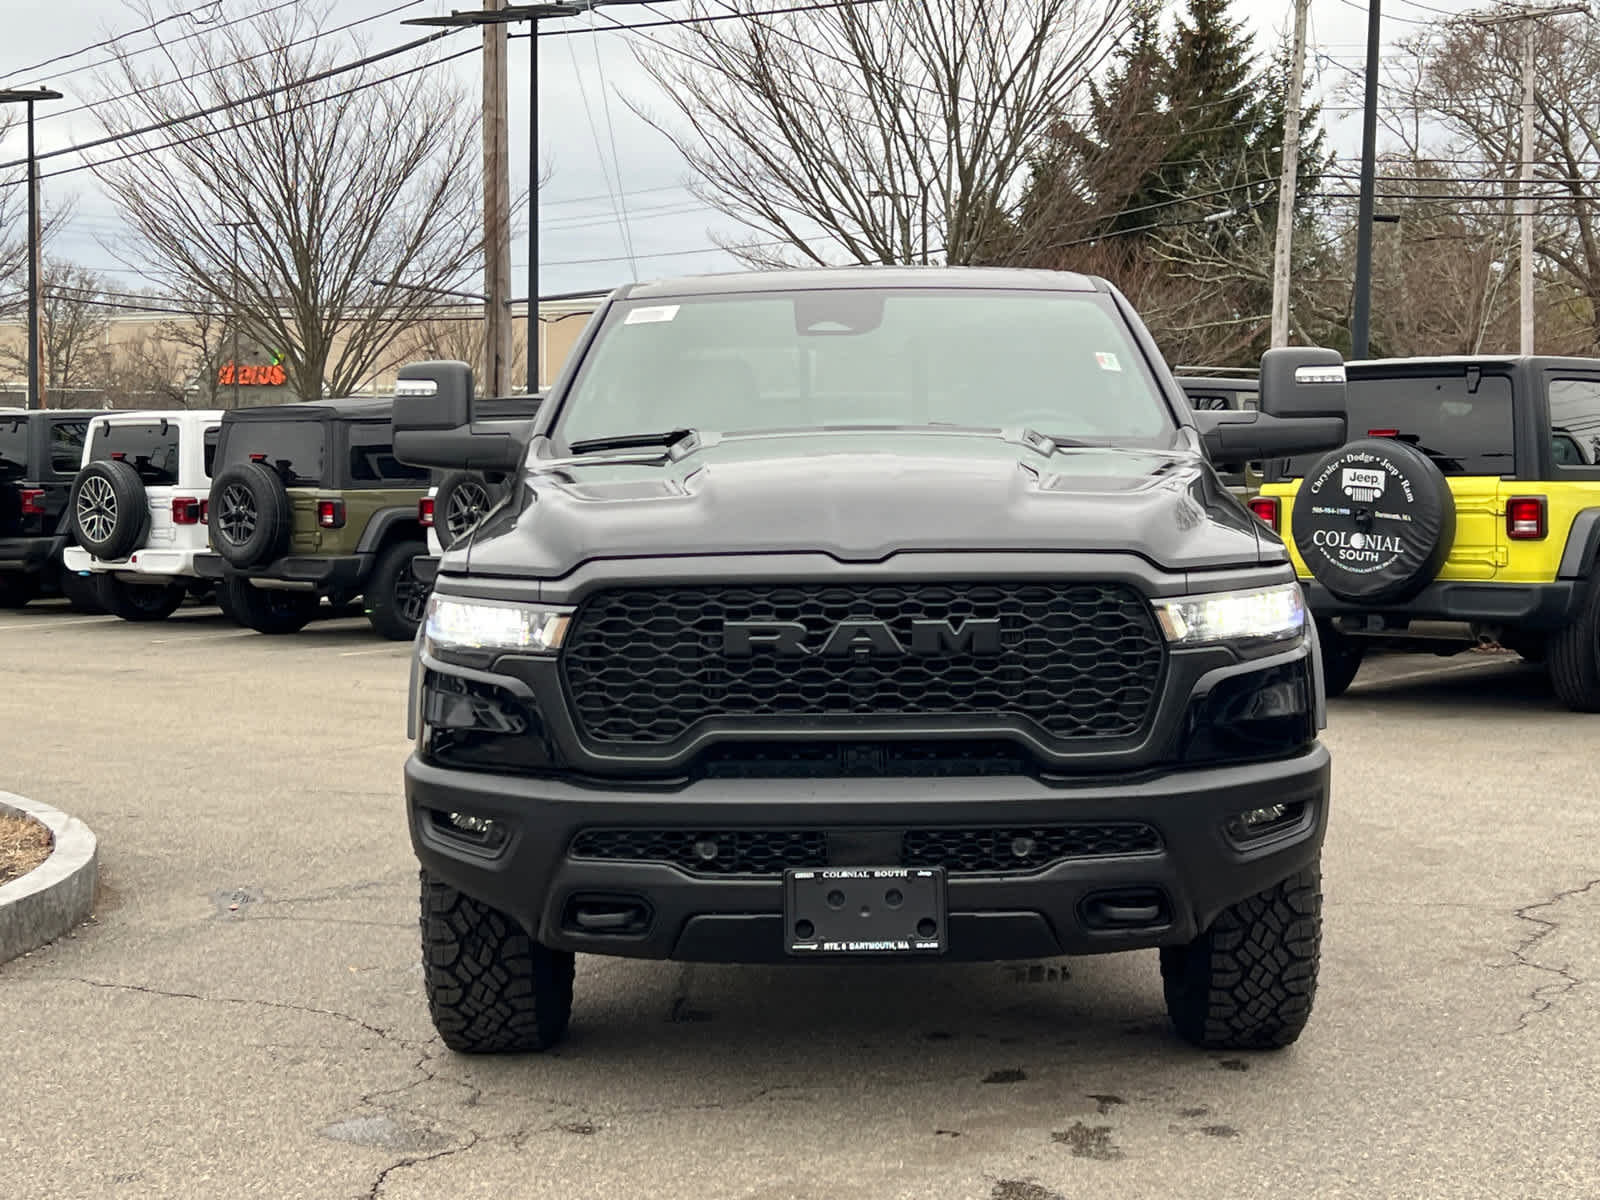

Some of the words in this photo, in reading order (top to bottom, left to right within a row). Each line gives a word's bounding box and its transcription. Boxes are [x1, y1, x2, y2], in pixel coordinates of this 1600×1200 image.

[1311, 459, 1340, 494] Chrysler
[1346, 452, 1375, 465] Dodge
[1379, 458, 1399, 476] Jeep
[1401, 479, 1414, 503] Ram
[1349, 471, 1378, 485] Jeep
[1313, 530, 1404, 553] COLONIAL
[1339, 550, 1379, 562] SOUTH
[723, 618, 1000, 655] RAM
[874, 870, 907, 878] SOUTH
[898, 941, 910, 950] MA
